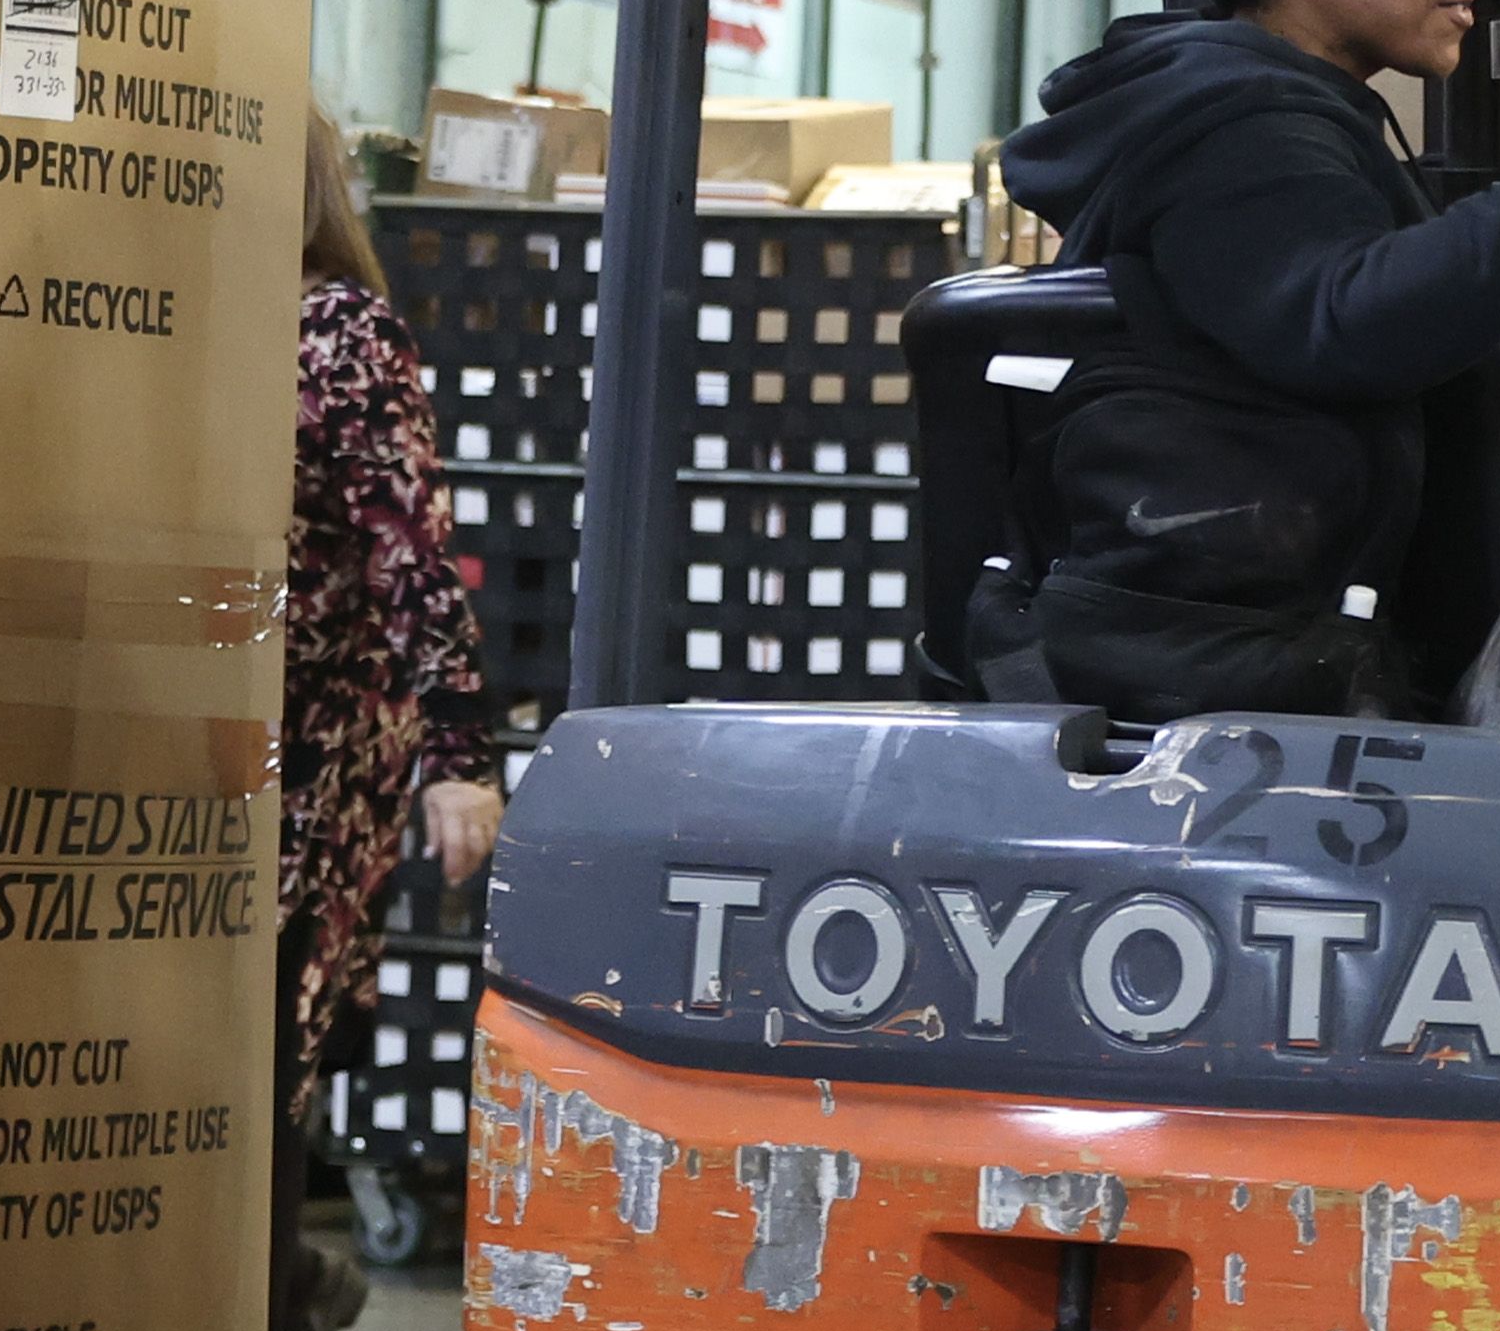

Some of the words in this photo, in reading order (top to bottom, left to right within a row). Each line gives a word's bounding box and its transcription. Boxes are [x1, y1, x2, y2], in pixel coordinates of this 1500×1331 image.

[42, 278, 174, 338] RECYCLE
[127, 793, 253, 856] STATES
[1199, 730, 1427, 868] 25
[108, 870, 255, 939] SERVICE
